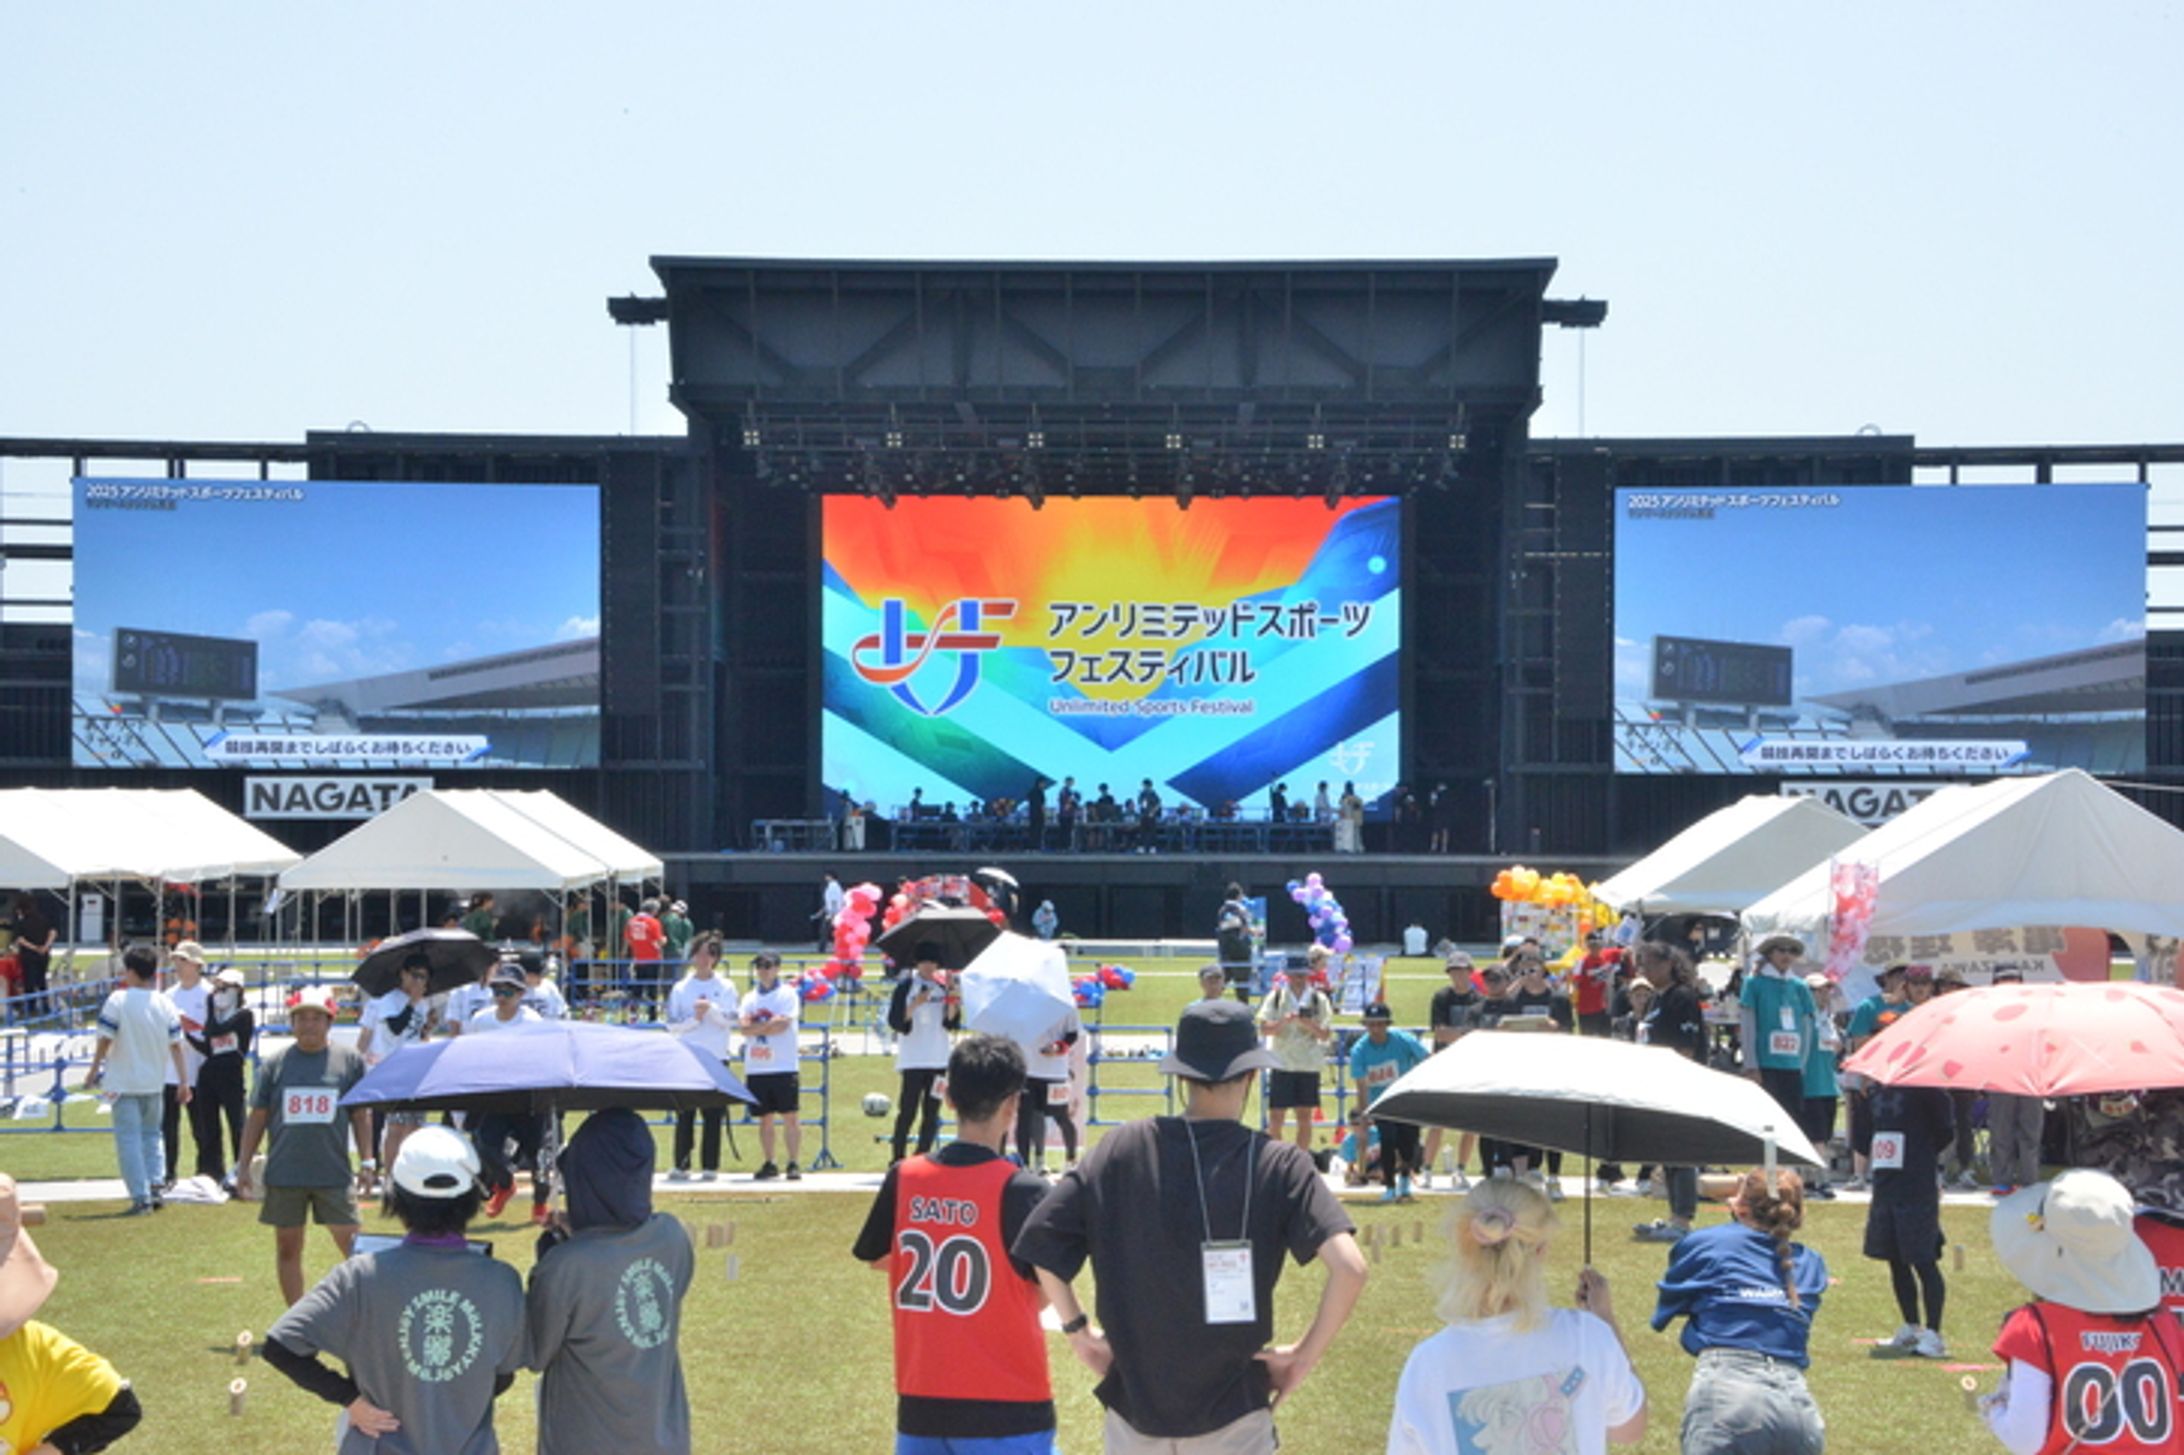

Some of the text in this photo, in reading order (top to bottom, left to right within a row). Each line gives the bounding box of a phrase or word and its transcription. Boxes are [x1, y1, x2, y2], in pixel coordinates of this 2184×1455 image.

[1048, 601, 1370, 638] アンリミテッドスポーツ
[1049, 650, 1256, 685] フェスティバル
[1050, 698, 1254, 718] Unlimited Sports Festival
[288, 1095, 330, 1114] 818
[910, 1195, 979, 1227] SATO
[896, 1229, 991, 1315] 20
[2061, 1356, 2174, 1445] 00
